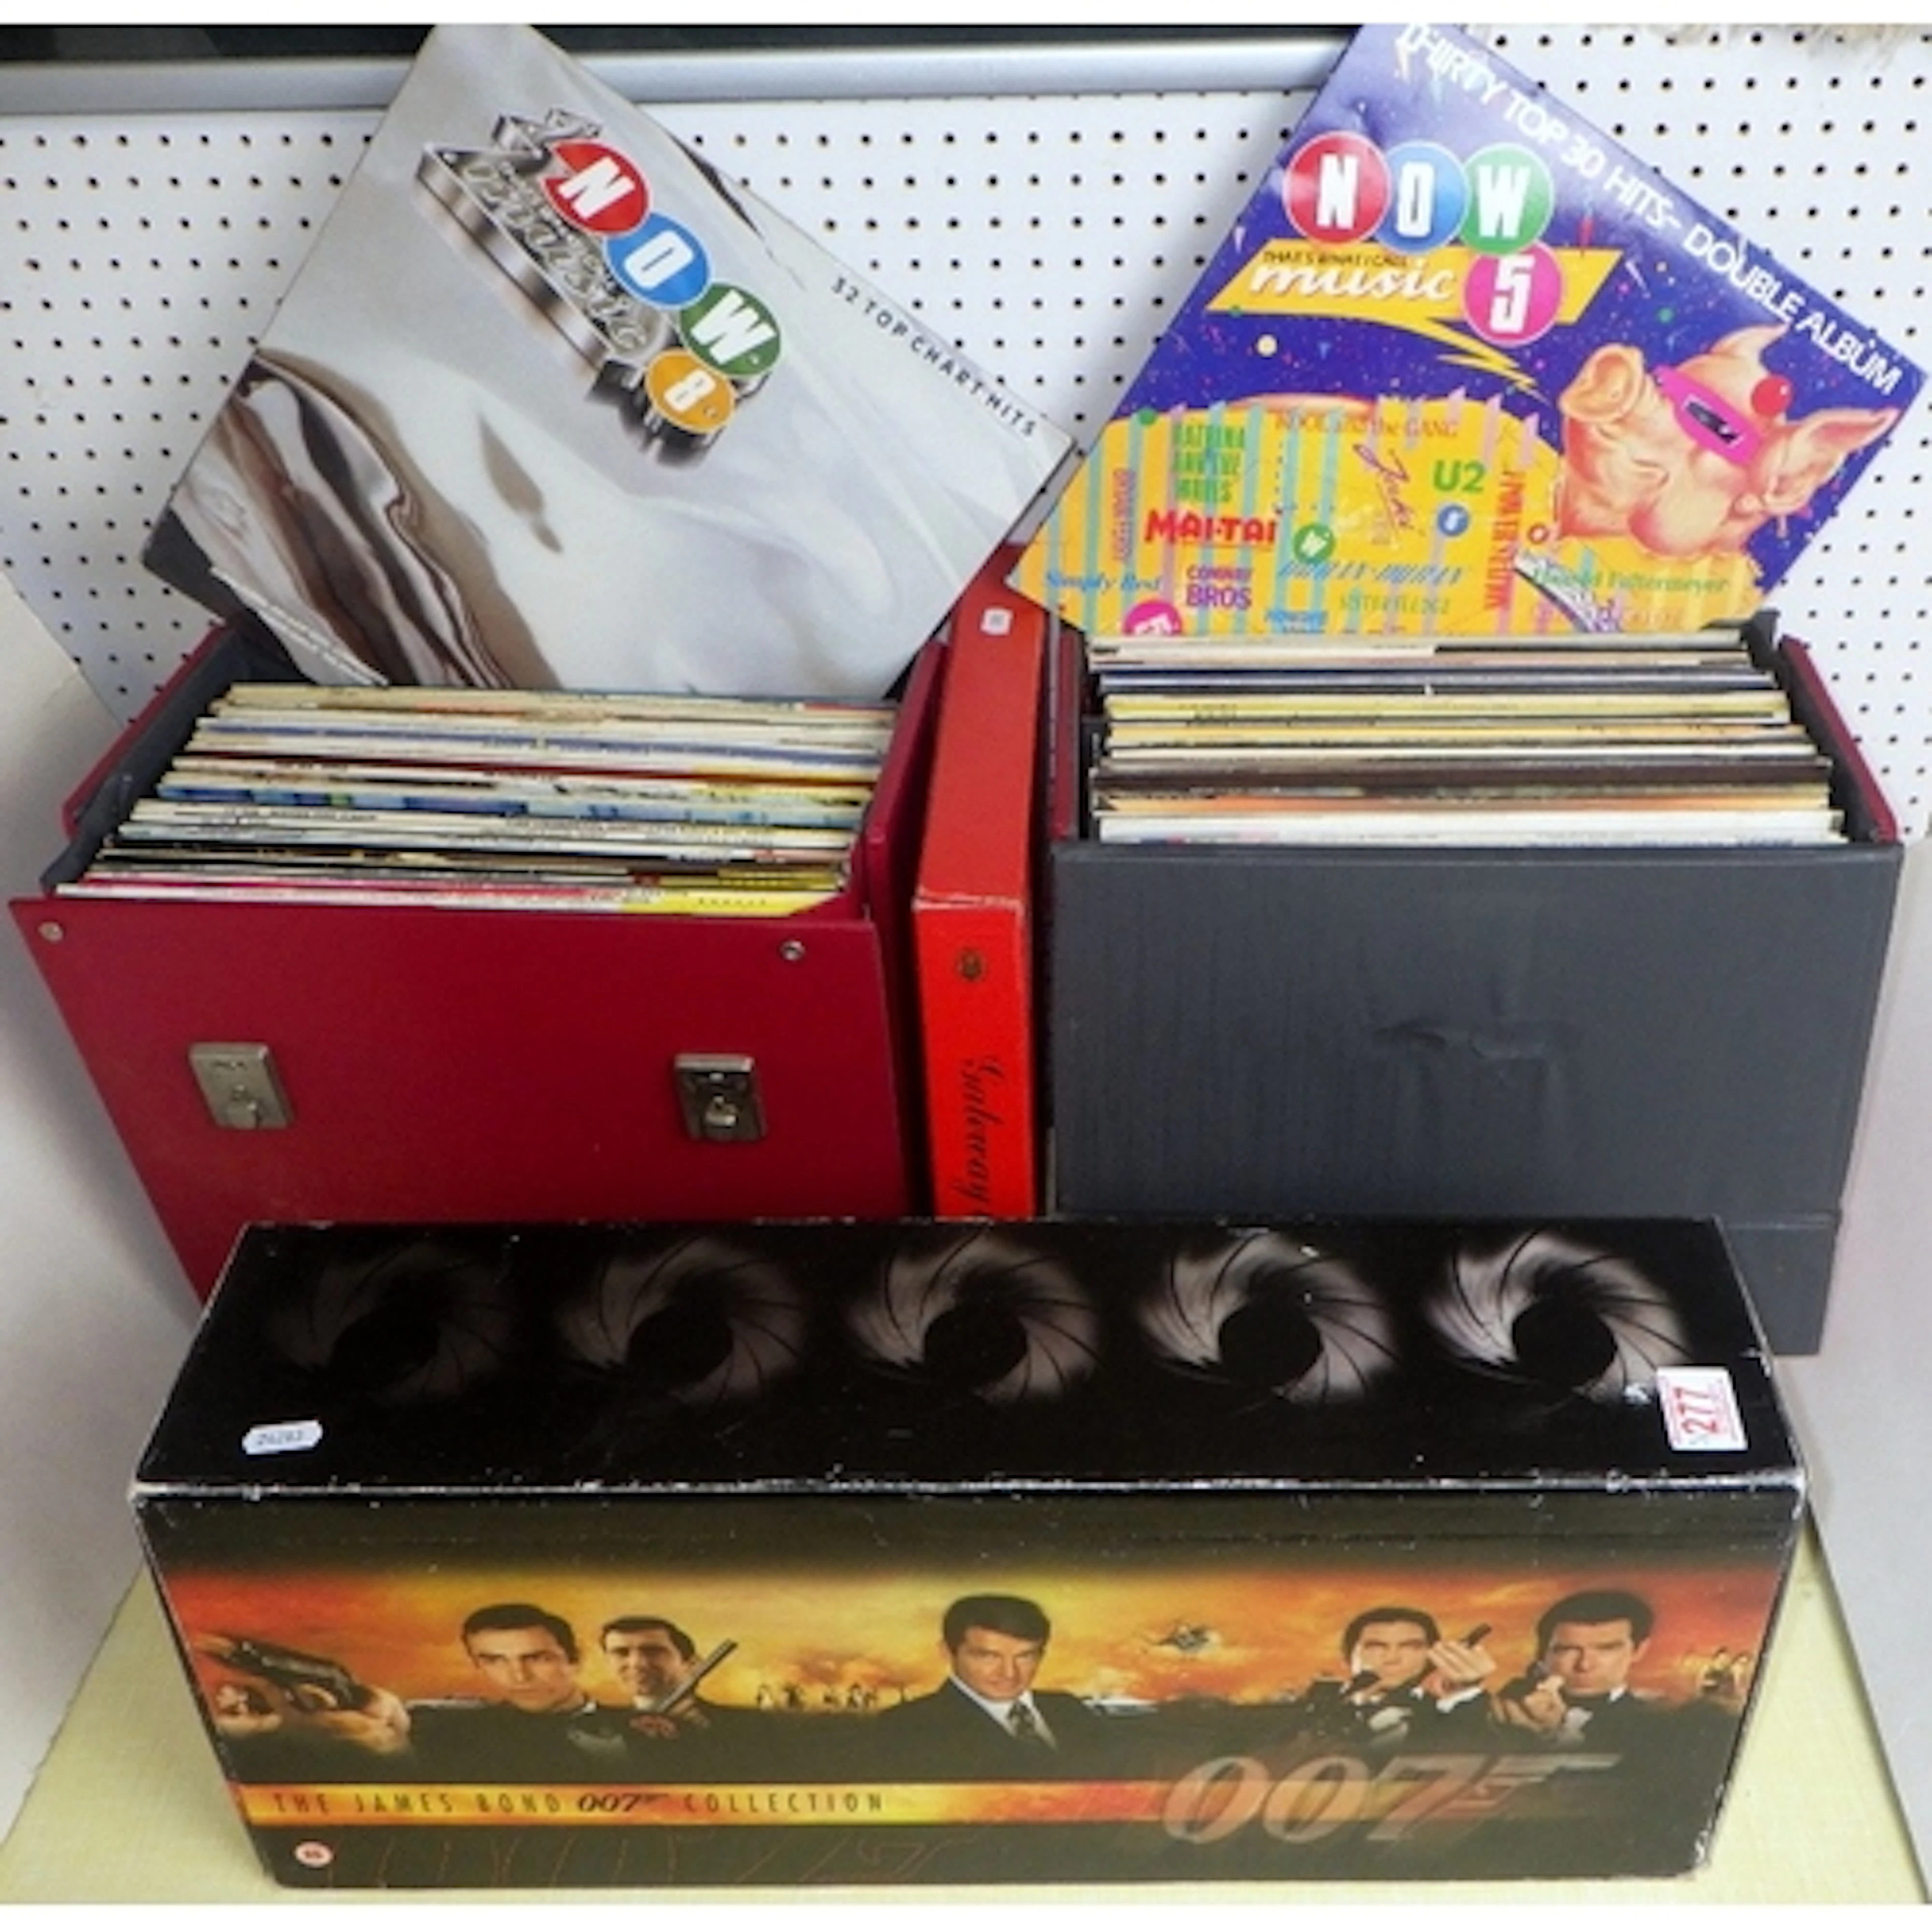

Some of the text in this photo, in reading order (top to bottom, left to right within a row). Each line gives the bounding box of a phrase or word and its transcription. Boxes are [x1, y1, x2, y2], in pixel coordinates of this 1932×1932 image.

[1316, 153, 1533, 239] NOW
[556, 155, 776, 366] NOW
[1249, 256, 1457, 301] music
[1502, 89, 1569, 144] TOP
[1560, 135, 1606, 178] 30
[1683, 223, 1806, 324] DOUBLE
[1795, 311, 1903, 396] ALBUM
[1489, 254, 1536, 333] 5
[832, 277, 1056, 436] 32 TOP CHART HITS
[1433, 460, 1486, 493] U2
[1186, 584, 1252, 609] BROS
[1673, 1386, 1720, 1433] 277
[272, 1792, 882, 1815] THE JAMES BOND 007 COLLECTION
[1160, 1753, 1550, 1844] 007
